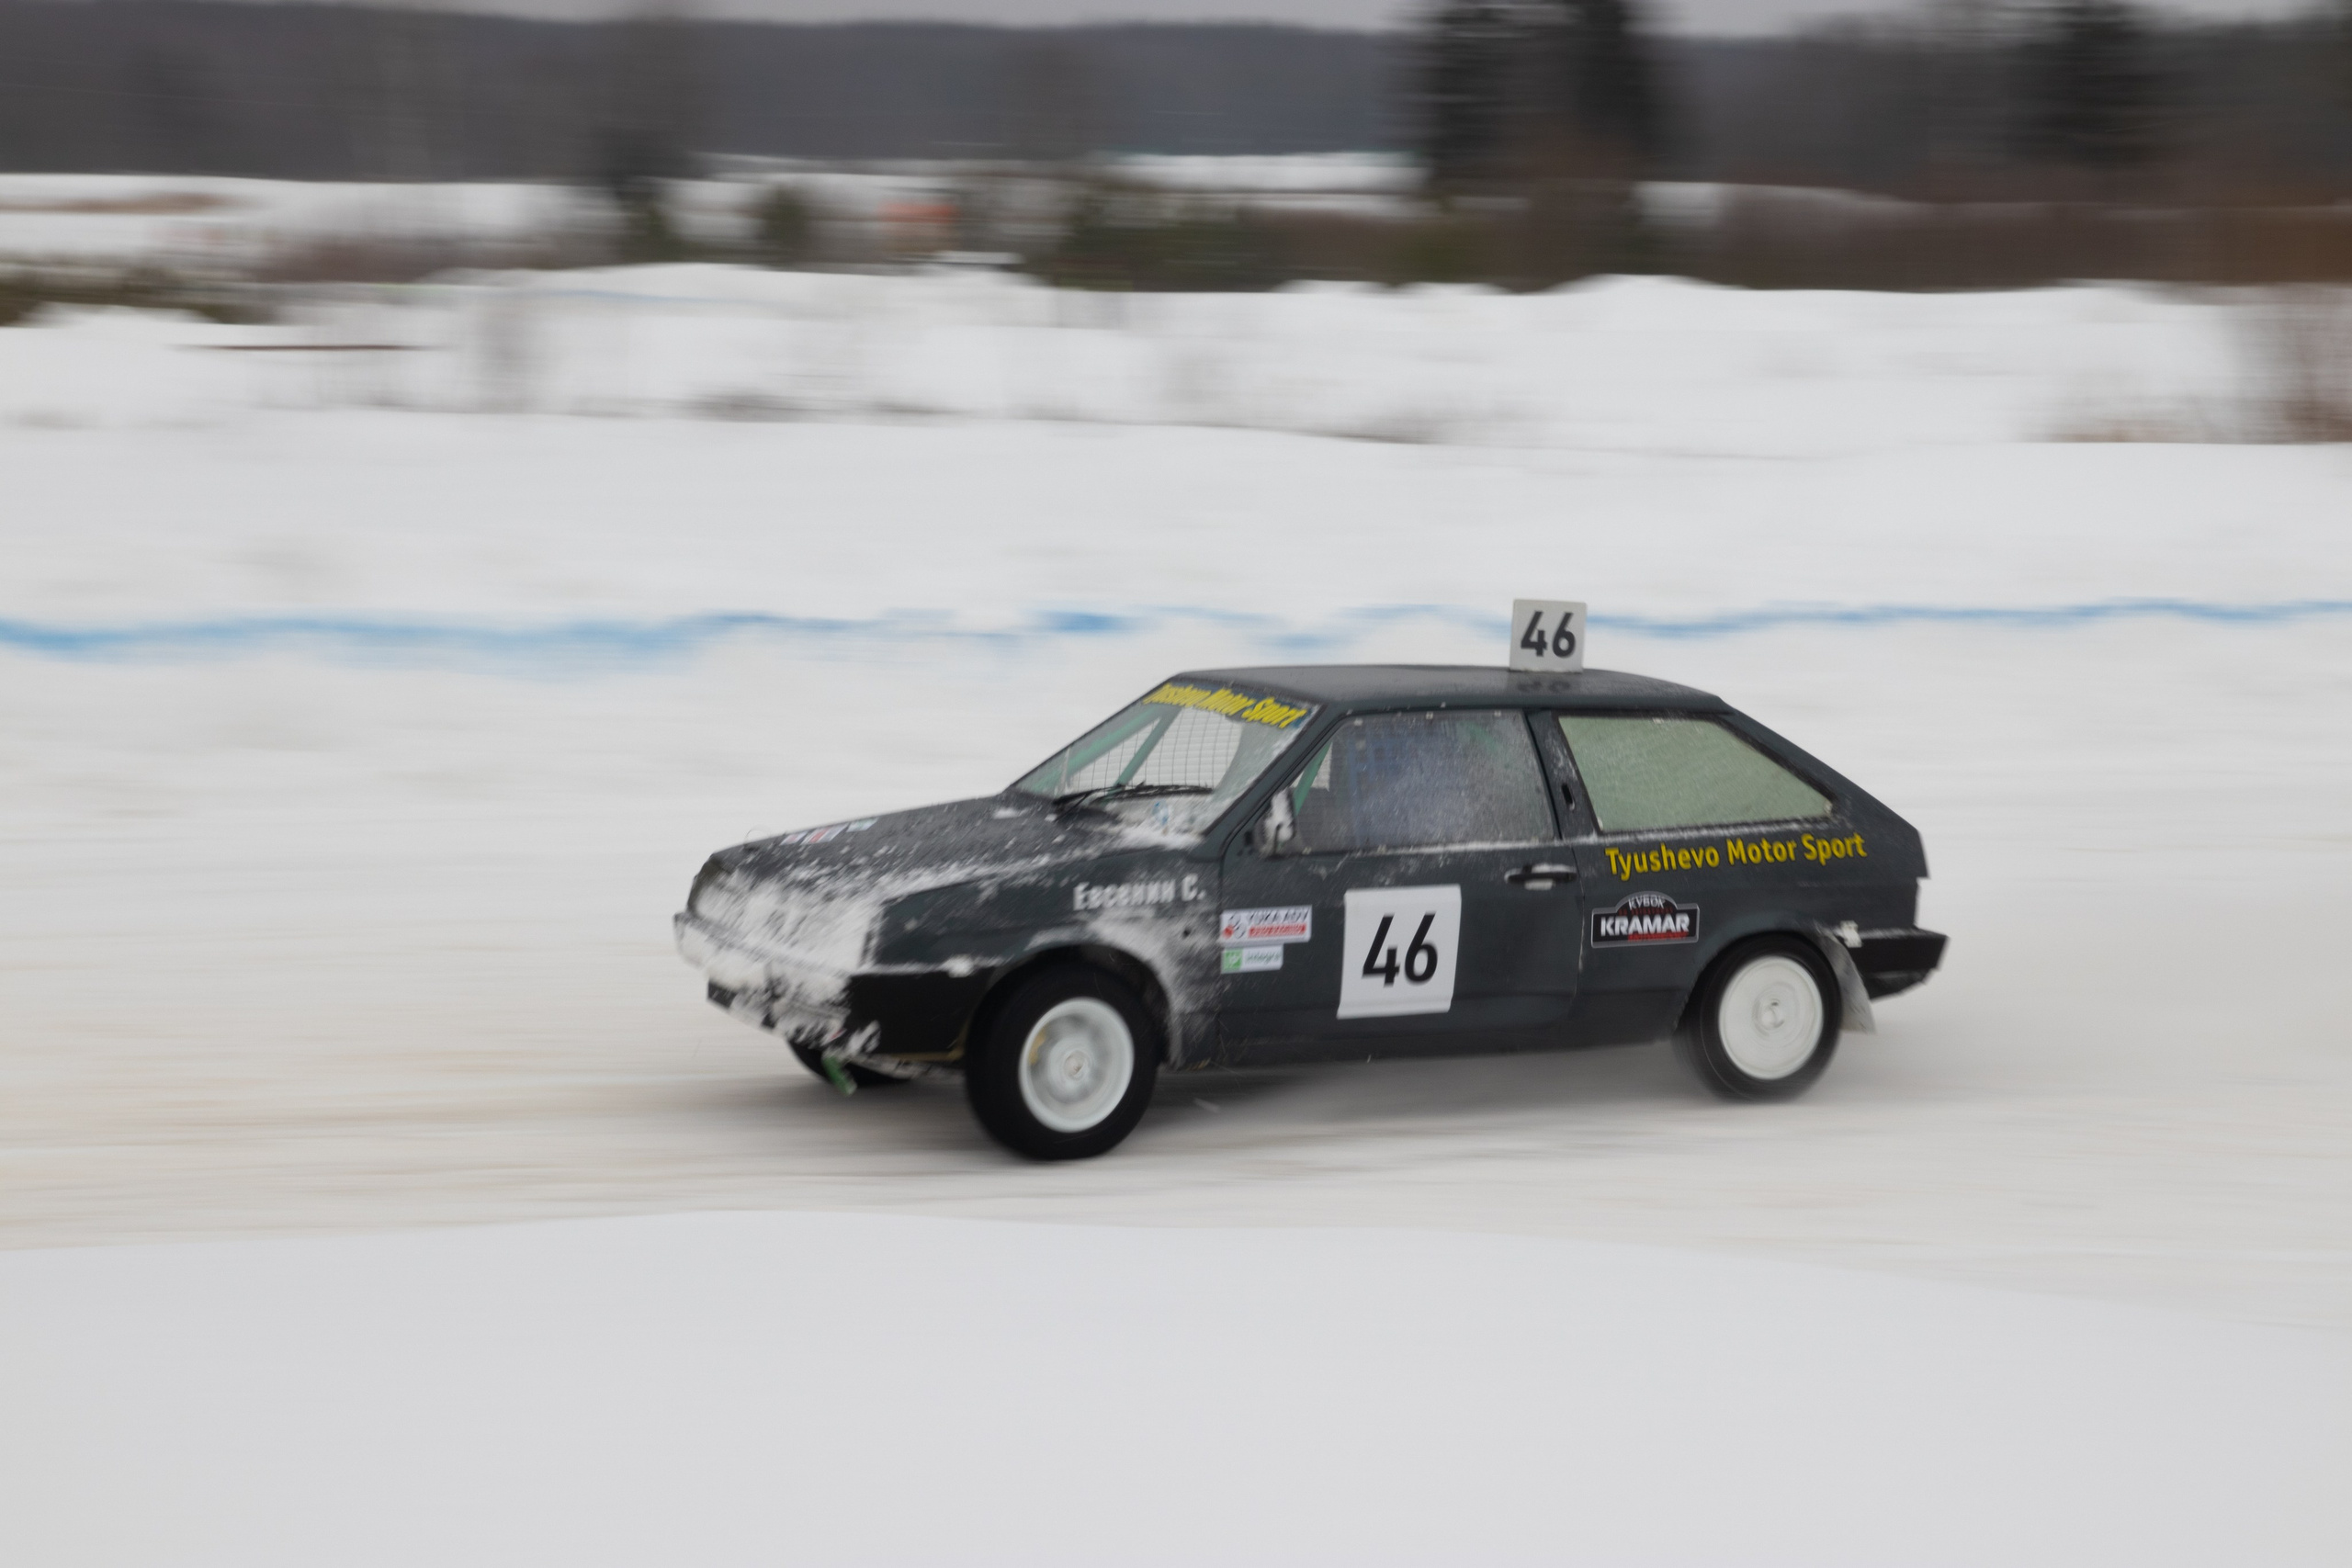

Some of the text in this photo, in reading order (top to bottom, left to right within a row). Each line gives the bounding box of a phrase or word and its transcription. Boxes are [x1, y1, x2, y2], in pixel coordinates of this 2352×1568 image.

[1521, 611, 1576, 659] 46
[1241, 696, 1307, 728] Sport
[1605, 832, 1868, 881] Tyushevo Motor Sport
[1600, 913, 1690, 937] KRAMAR
[1362, 912, 1438, 987] 46
